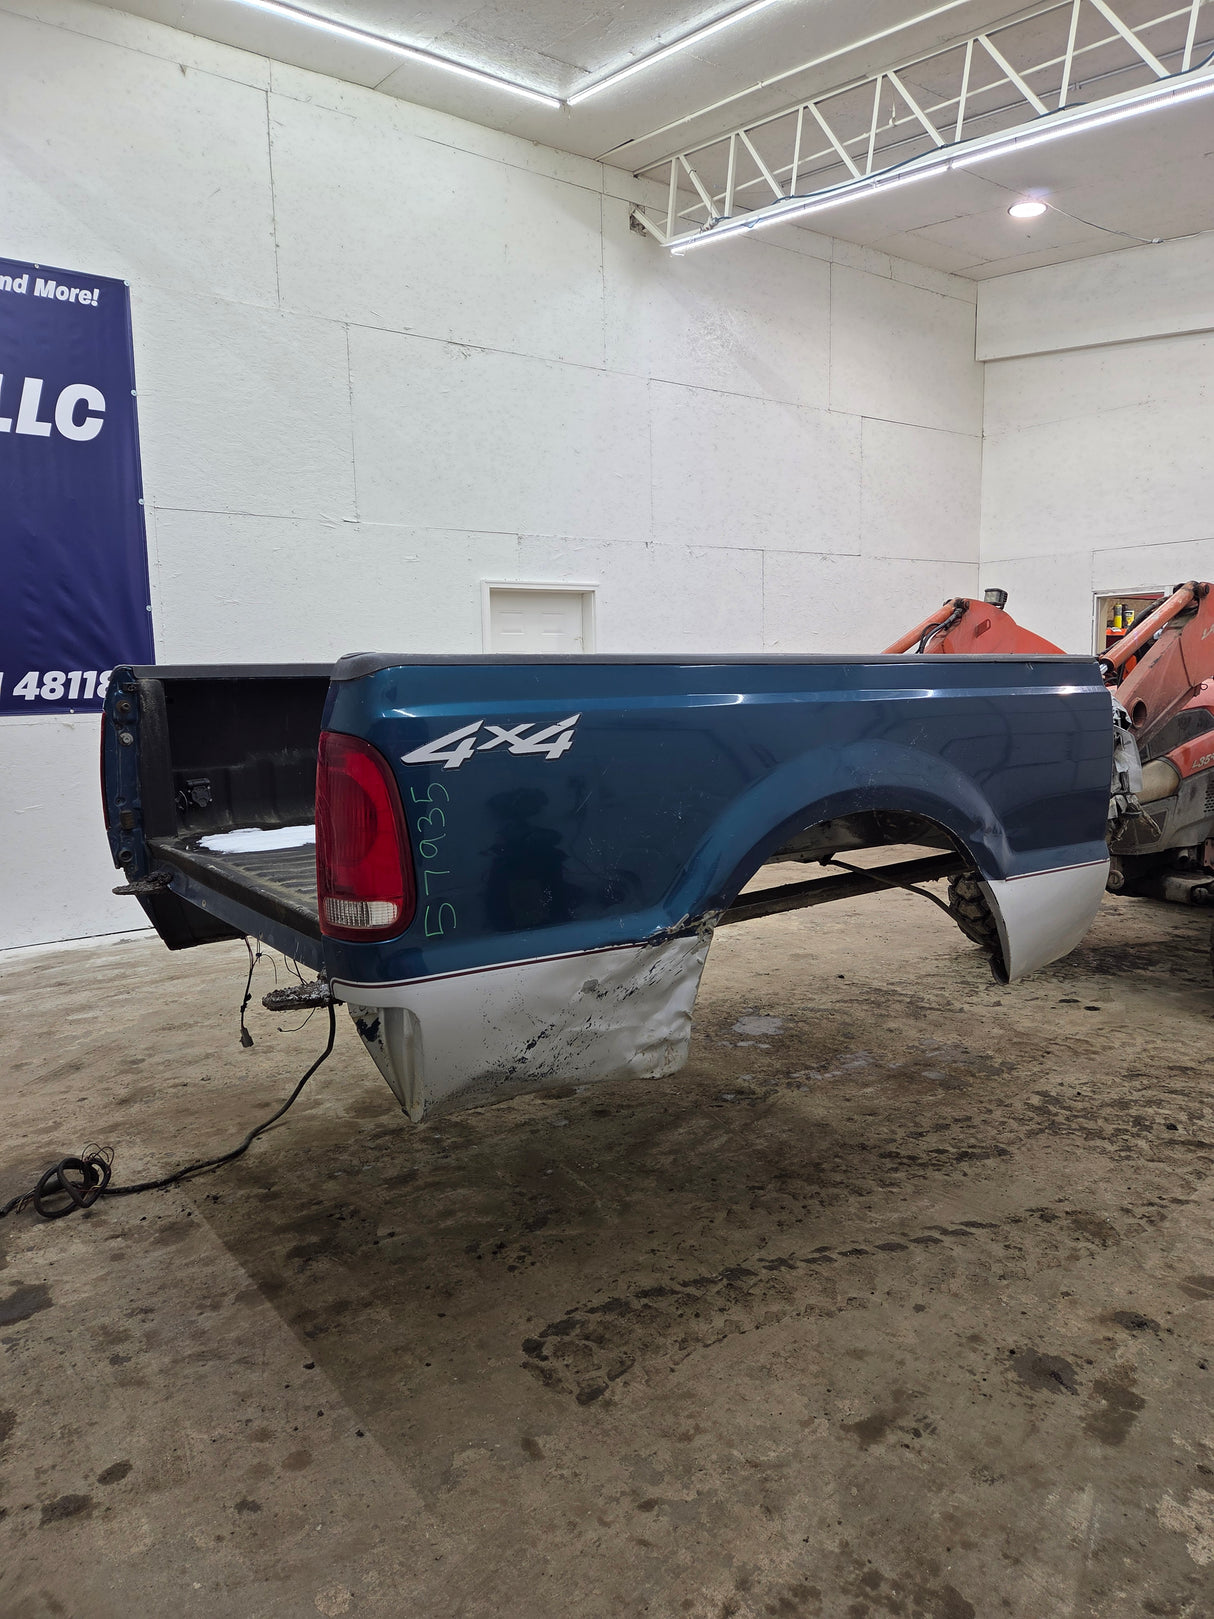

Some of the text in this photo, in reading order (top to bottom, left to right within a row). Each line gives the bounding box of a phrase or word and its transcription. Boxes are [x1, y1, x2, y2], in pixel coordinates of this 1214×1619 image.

[33, 278, 100, 306] More!
[401, 712, 582, 770] 4x4
[410, 782, 457, 937] 57935
